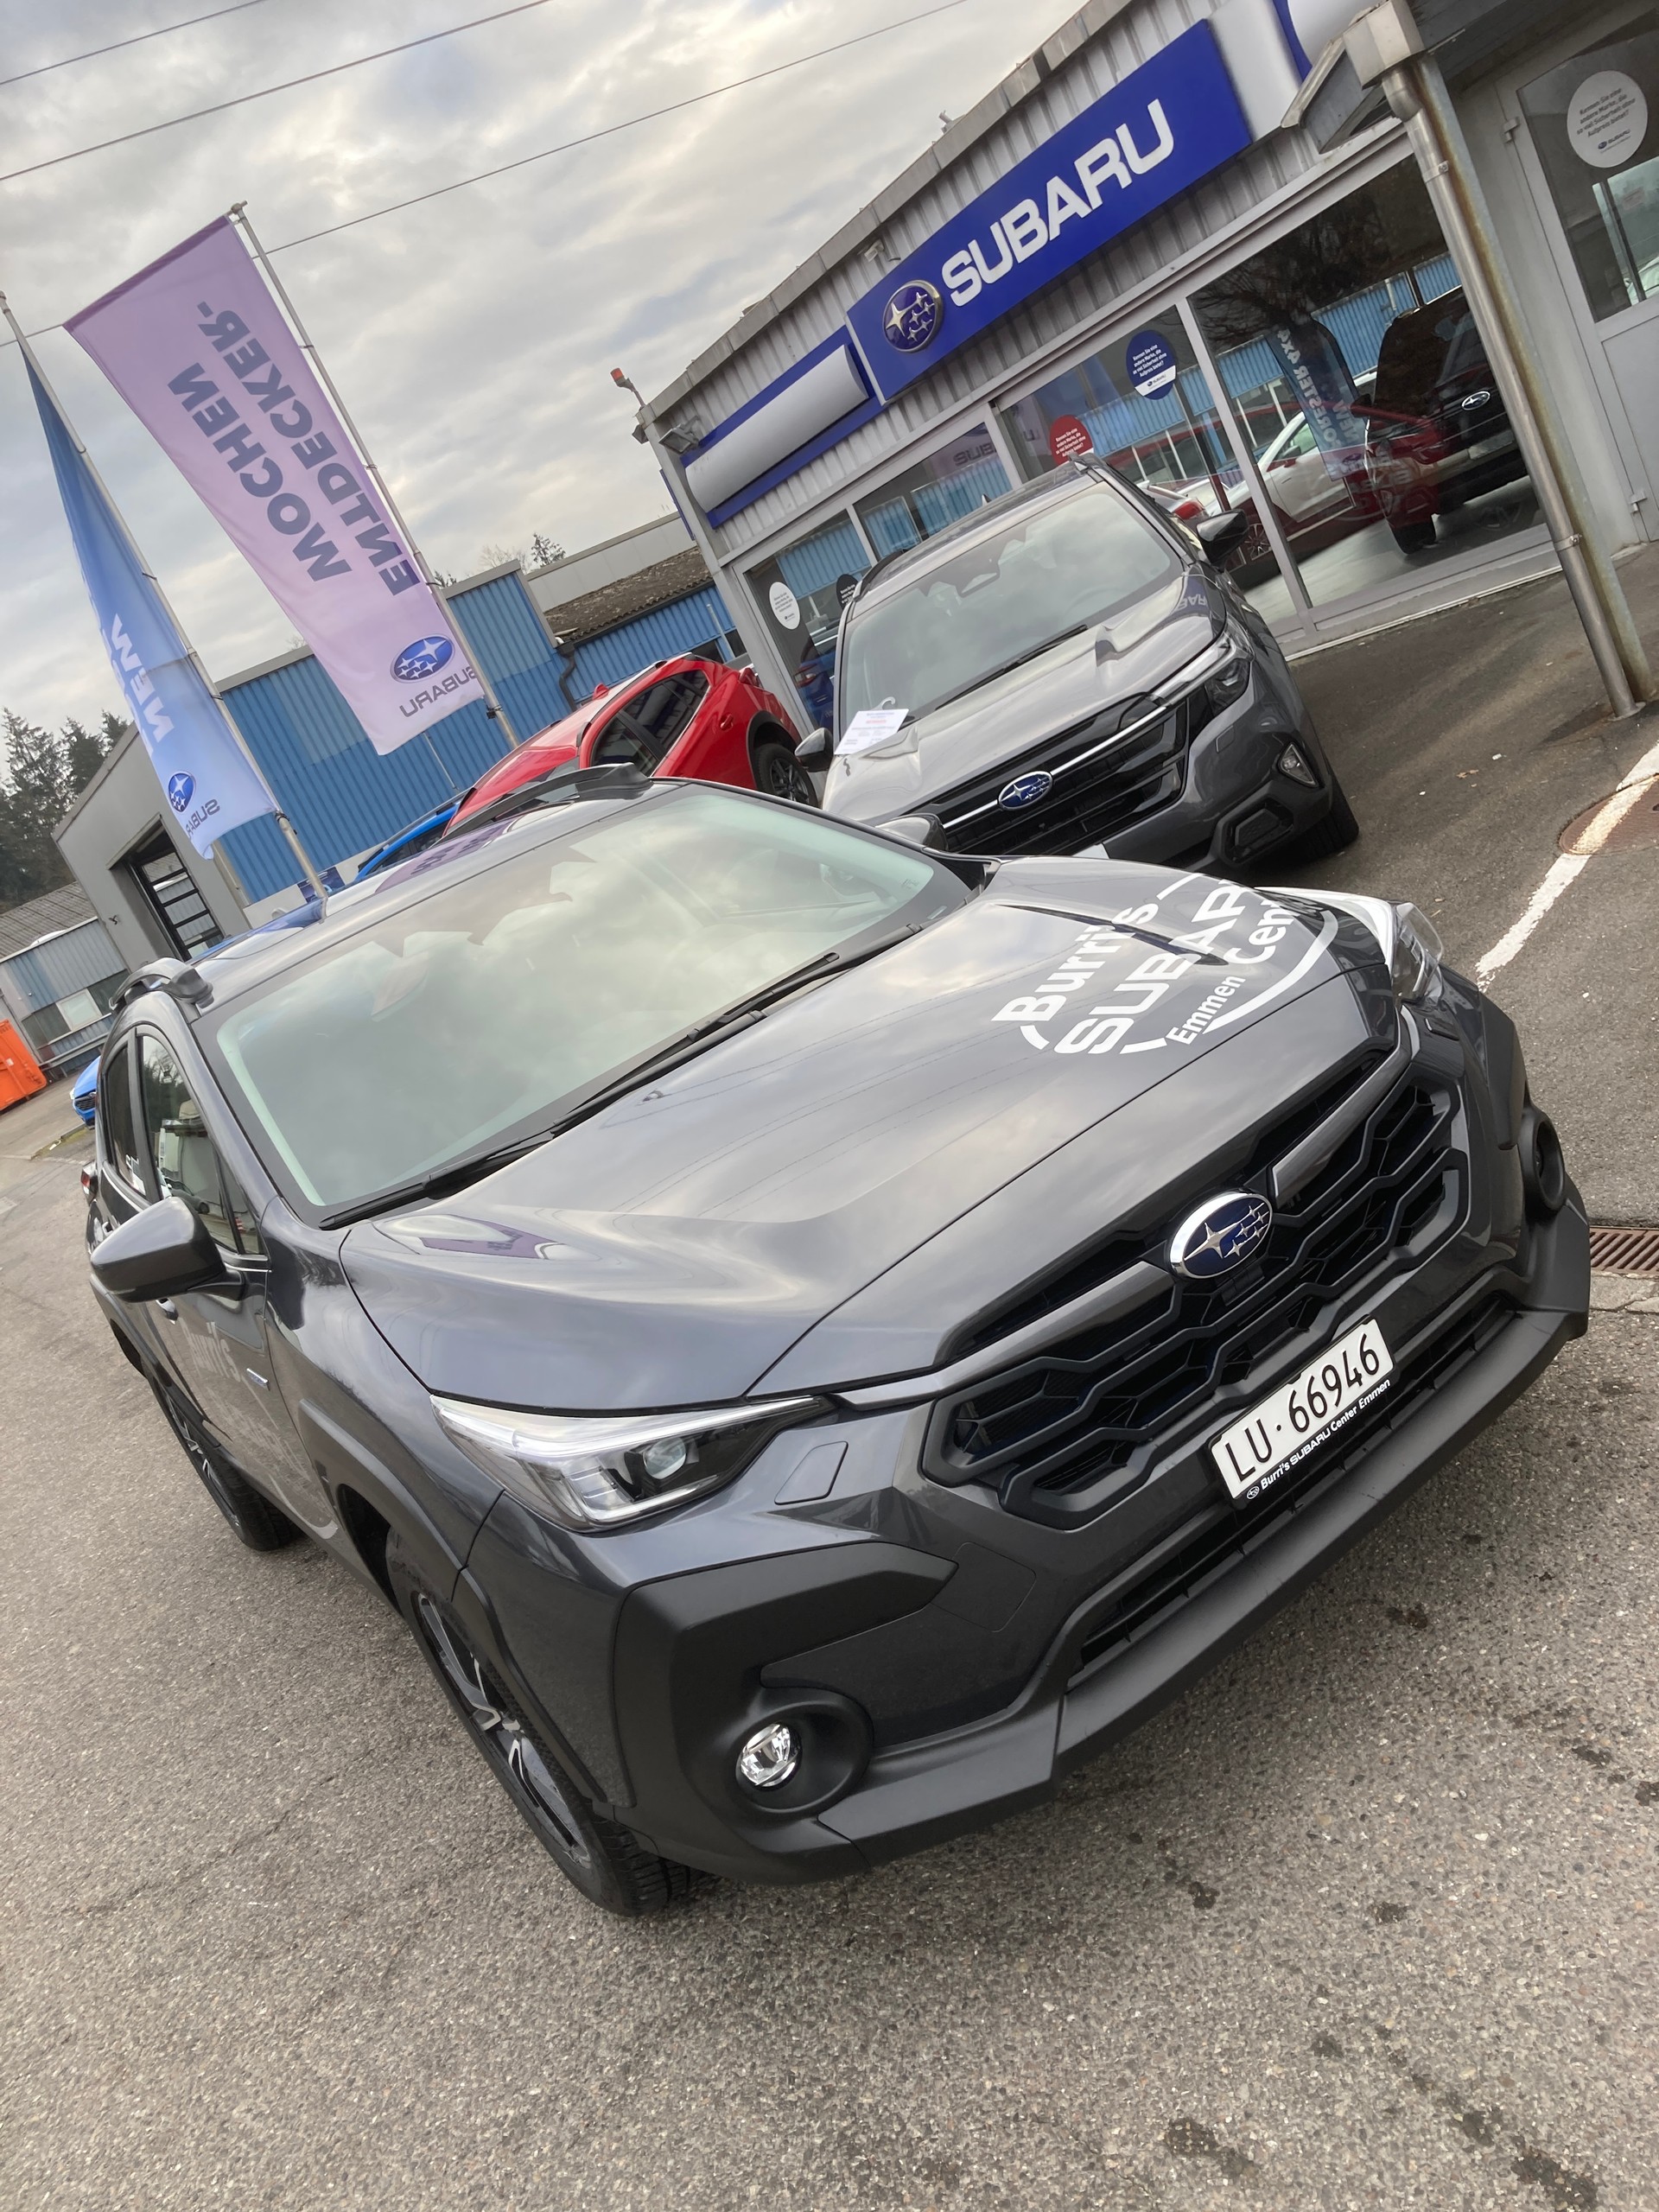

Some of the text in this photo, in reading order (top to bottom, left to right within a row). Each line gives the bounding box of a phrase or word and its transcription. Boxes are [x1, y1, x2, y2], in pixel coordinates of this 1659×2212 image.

[940, 99, 1174, 307] SUBARU
[991, 904, 1158, 1021] Burri's
[1166, 976, 1245, 1045] Emmen
[1260, 1379, 1390, 1490] Burri's SUBARU Center Emmen
